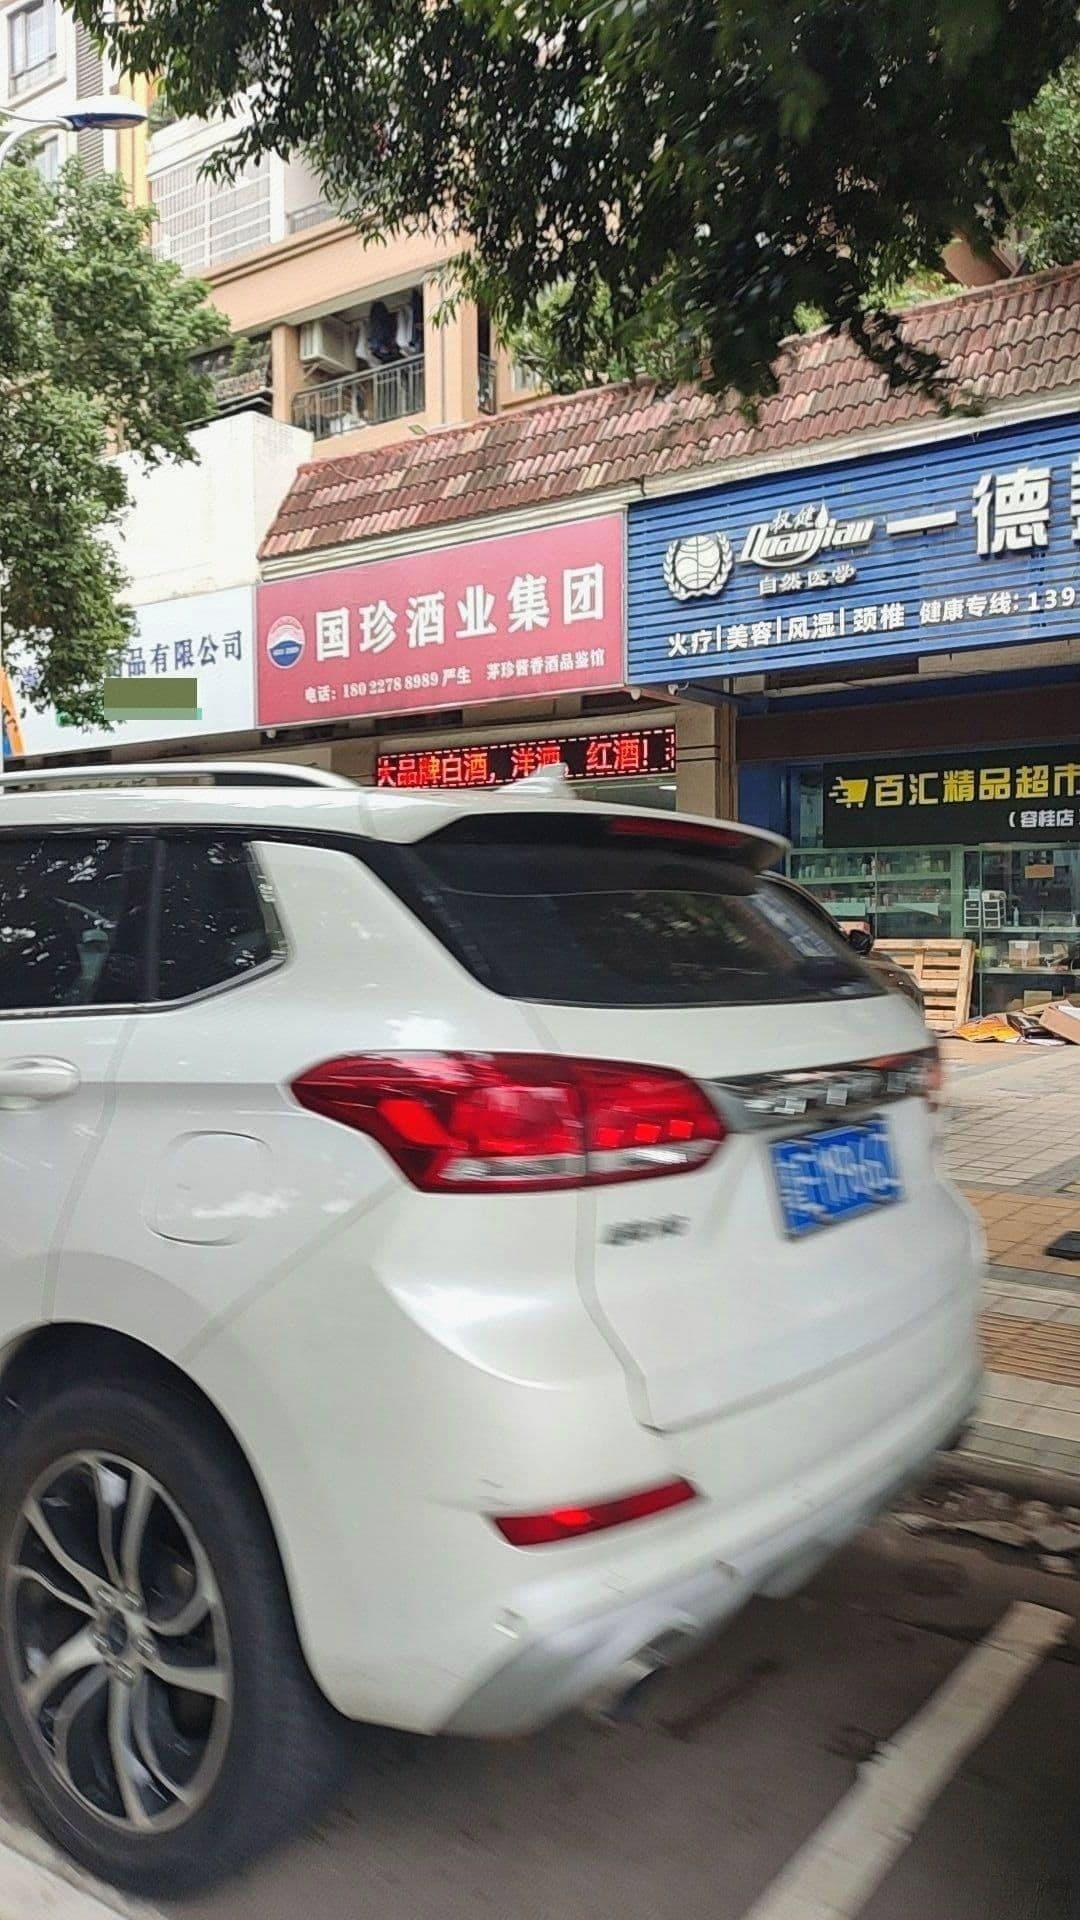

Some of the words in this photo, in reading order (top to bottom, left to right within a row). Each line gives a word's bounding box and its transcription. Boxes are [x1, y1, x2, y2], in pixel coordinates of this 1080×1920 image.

[759, 564, 856, 595] 自然医学
[315, 563, 605, 661] 国珍酒业集团
[874, 763, 1080, 807] 百汇精品超市
